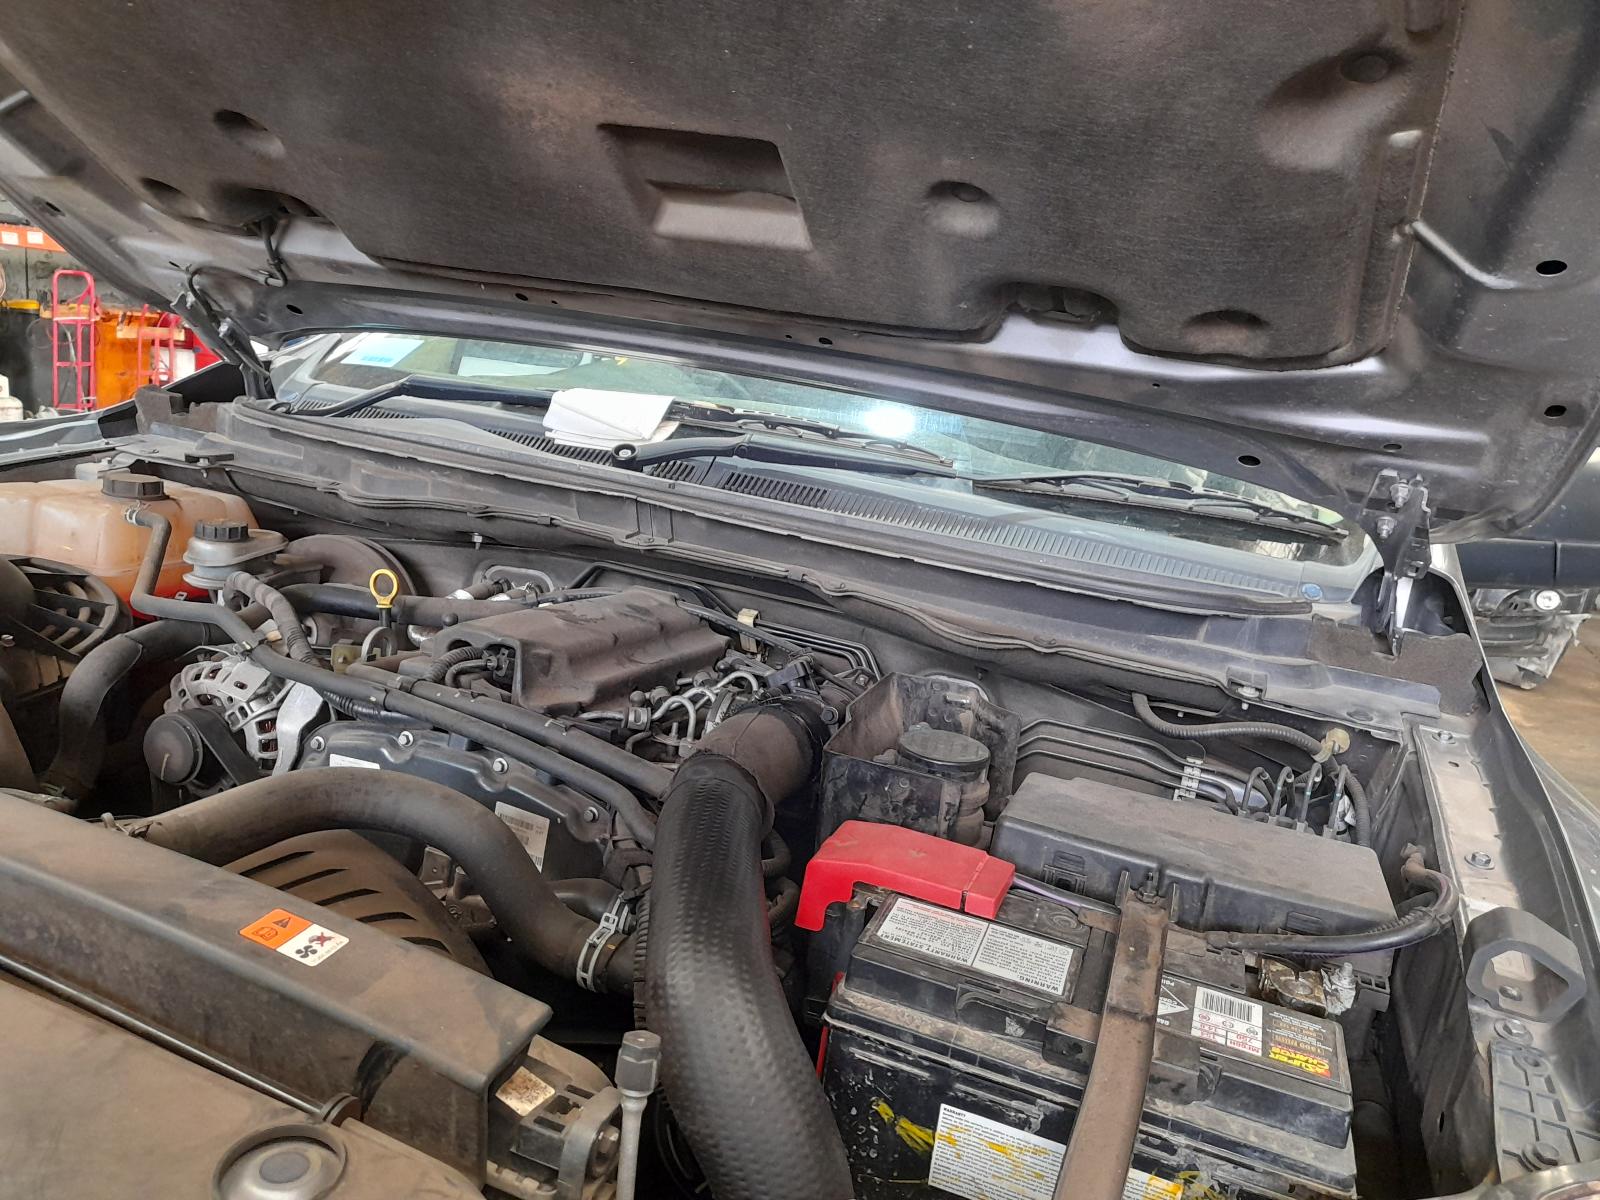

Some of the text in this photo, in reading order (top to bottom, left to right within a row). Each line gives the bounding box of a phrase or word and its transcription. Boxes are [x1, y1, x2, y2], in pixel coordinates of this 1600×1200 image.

[880, 933, 968, 963] WARRANTY STATEMENT
[1268, 1051, 1315, 1072] SUPER
[1271, 1046, 1330, 1070] CHARGE
